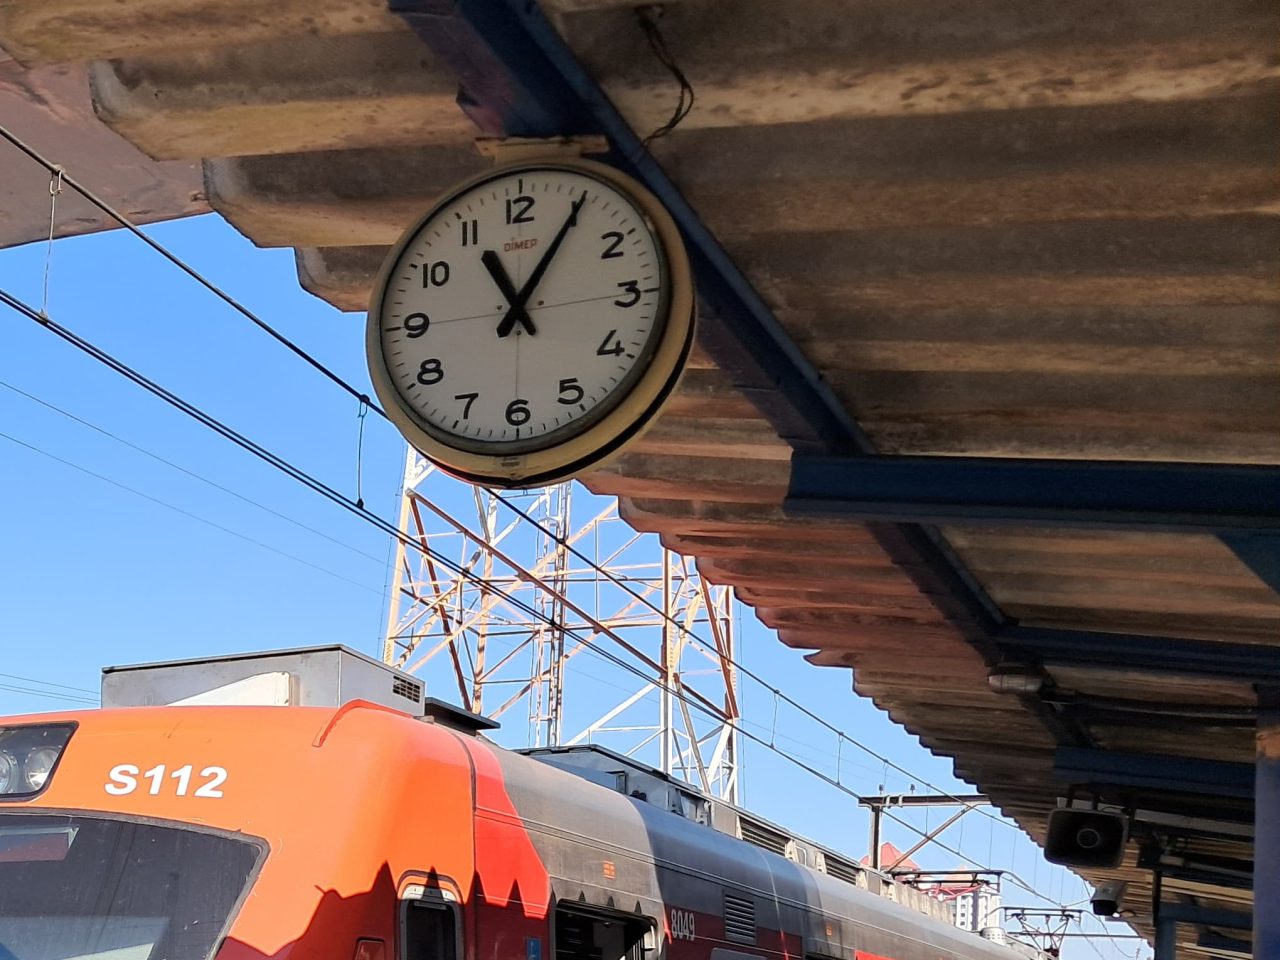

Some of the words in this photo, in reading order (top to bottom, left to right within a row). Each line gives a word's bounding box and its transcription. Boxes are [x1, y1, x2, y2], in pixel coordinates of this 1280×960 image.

[505, 195, 535, 224] 12
[461, 219, 478, 247] 11
[600, 231, 625, 260] 2
[422, 260, 450, 288] 10
[614, 280, 641, 307] 3
[403, 312, 430, 338] 9
[596, 329, 625, 356] 4
[416, 358, 444, 385] 8
[557, 377, 584, 405] 5
[454, 392, 479, 419] 7
[505, 399, 531, 426] 6
[104, 763, 229, 799] S112
[671, 909, 695, 941] 8049
